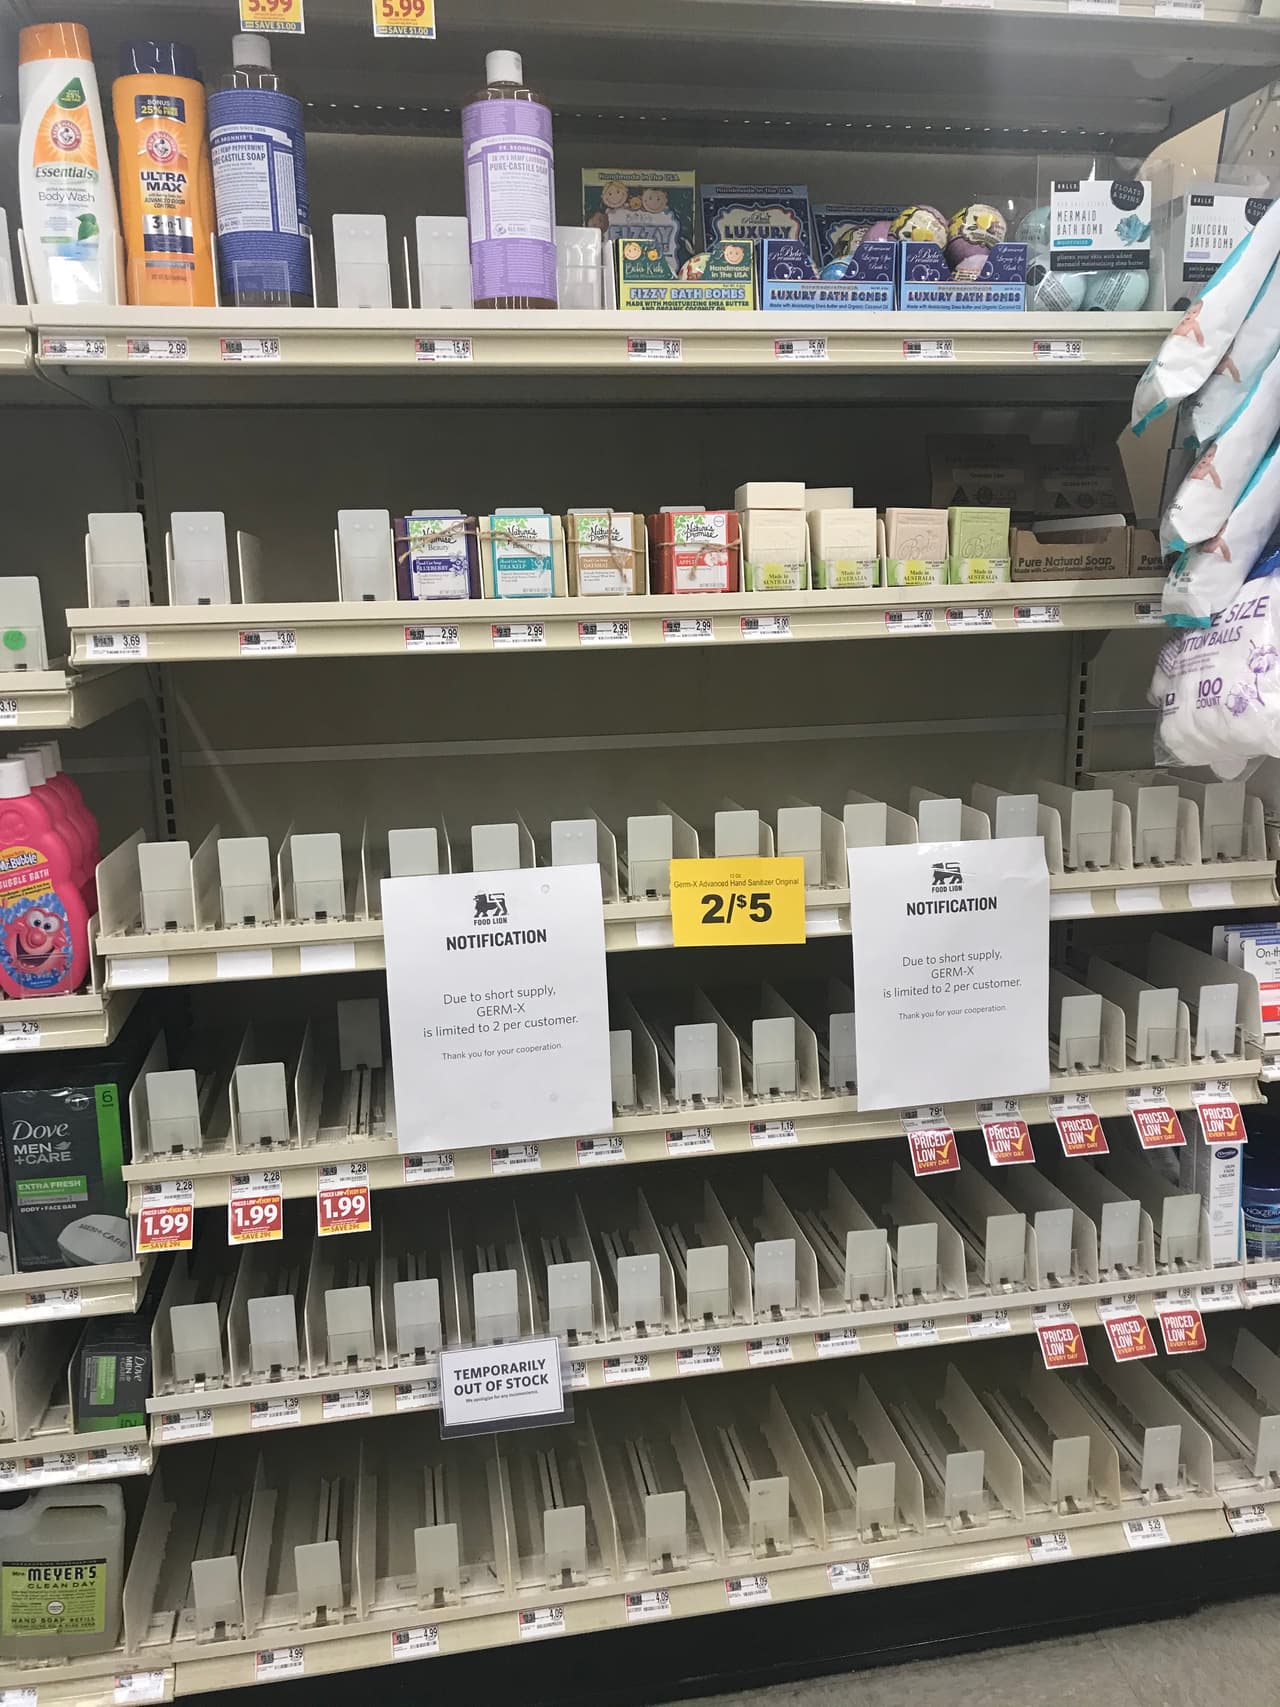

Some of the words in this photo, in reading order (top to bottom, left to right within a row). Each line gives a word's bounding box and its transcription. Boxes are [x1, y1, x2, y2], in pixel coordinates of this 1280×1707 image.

[35, 166, 96, 180] Essentials
[140, 171, 187, 184] ULTRA
[146, 182, 182, 193] MAX
[39, 191, 66, 204] Body
[67, 192, 95, 203] Wash
[1057, 210, 1096, 222] MERMAID
[1057, 224, 1077, 236] BATH
[1081, 223, 1103, 235] BOMB
[1191, 224, 1228, 236] UNICORN
[1190, 236, 1210, 248] BATH
[1212, 237, 1234, 249] BOMB
[630, 288, 667, 300] FIZZY
[671, 288, 703, 299] BATH
[705, 288, 745, 299] BOMBS
[770, 290, 816, 301] LUXURY
[819, 290, 850, 301] BATH
[851, 291, 888, 302] BOMBS
[908, 291, 952, 302] LUXURY
[955, 291, 984, 302] BATH
[985, 292, 1021, 302] BOMBS
[86, 342, 105, 353] 2.99
[168, 343, 186, 354] 2.99
[261, 341, 278, 353] 15.49
[452, 341, 470, 353] 15.49
[1065, 343, 1080, 353] 3.99
[1018, 557, 1041, 568] Pure
[1045, 556, 1083, 567] Natural
[1086, 555, 1113, 568] Soap
[1225, 595, 1270, 624] SIZE
[441, 628, 457, 639] 2.99
[527, 625, 543, 636] 2.99
[123, 635, 140, 647] 3.69
[1198, 677, 1223, 698] 100
[0, 702, 16, 712] 3.19
[1196, 696, 1221, 710] COUNT
[673, 880, 697, 889] Germ-X
[698, 879, 729, 888] Advanced
[730, 879, 747, 887] Hand
[747, 878, 774, 887] Sanitizer
[775, 878, 799, 887] Original
[931, 885, 947, 893] FOOD
[948, 884, 962, 892] LION
[700, 892, 772, 924] 2/$5
[906, 896, 997, 917] NOTIFICATION
[473, 918, 490, 926] FOOD
[492, 916, 508, 925] LION
[446, 929, 548, 951] NOTIFICATION
[902, 954, 923, 967] Due
[926, 954, 937, 965] to
[939, 950, 965, 964] short
[967, 948, 1002, 964] supply,
[930, 965, 974, 980] GERM-X
[883, 987, 891, 999] is
[894, 985, 929, 999] limited
[931, 983, 942, 995] to
[944, 982, 951, 993] 2
[953, 982, 970, 995] per
[972, 976, 1022, 991] customer.
[443, 992, 468, 1005] Due
[469, 991, 482, 1003] to
[484, 987, 514, 1002] short
[517, 984, 557, 1002] supply,
[476, 1002, 526, 1018] GERM-X
[898, 1010, 920, 1021] Thank
[921, 1010, 934, 1020] you
[935, 1008, 945, 1018] for
[947, 1008, 963, 1018] your
[964, 1003, 1007, 1016] cooperation.
[23, 1022, 40, 1033] 2.79
[423, 1026, 433, 1038] is
[435, 1022, 475, 1037] limited
[477, 1022, 490, 1034] to
[492, 1020, 501, 1032] 2
[503, 1019, 522, 1034] per
[524, 1014, 579, 1030] customer.
[442, 1050, 466, 1062] Thank
[467, 1050, 482, 1061] you
[484, 1048, 495, 1058] for
[497, 1048, 515, 1058] your
[516, 1041, 564, 1055] cooperation.
[101, 1090, 114, 1104] 6
[1138, 1110, 1169, 1125] PRICED
[1202, 1106, 1234, 1120] PRICED
[12, 1119, 70, 1141] Dove
[1061, 1118, 1093, 1133] PRICED
[1142, 1123, 1162, 1137] LOW
[1206, 1118, 1225, 1132] LOW
[697, 1128, 711, 1138] 1.19
[988, 1124, 1020, 1141] PRICED
[1064, 1131, 1084, 1145] LOW
[608, 1138, 623, 1148] 1.19
[914, 1134, 947, 1149] PRICED
[990, 1139, 1012, 1153] LOW
[14, 1142, 52, 1155] MEN
[524, 1146, 539, 1156] 1.19
[15, 1152, 72, 1165] +CARE
[438, 1155, 453, 1165] 1.19
[916, 1149, 937, 1163] LOW
[350, 1163, 367, 1173] 2.28
[263, 1171, 280, 1182] 2.28
[18, 1181, 49, 1191] EXTRA
[51, 1180, 81, 1189] FRESH
[176, 1181, 193, 1192] 2.28
[322, 1196, 366, 1218] 1.99
[234, 1204, 278, 1226] 1.99
[144, 1214, 188, 1236] 1.99
[62, 1288, 80, 1300] 7.49
[995, 1310, 1008, 1319] 2.19
[922, 1319, 935, 1329] 2.19
[1109, 1320, 1140, 1335] PRICED
[844, 1329, 856, 1338] 2.19
[1113, 1334, 1132, 1348] LOW
[453, 1357, 546, 1380] TEMPORARILY
[570, 1361, 585, 1372] 1.39
[453, 1380, 483, 1396] OUT
[486, 1378, 504, 1393] OF
[506, 1371, 549, 1391] STOCK
[354, 1389, 370, 1399] 1.39
[284, 1398, 299, 1408] 1.39
[60, 1453, 75, 1464] 2.39
[856, 1560, 869, 1572] 4.09
[28, 1566, 97, 1581] MEYER'S
[72, 1580, 95, 1588] DAY
[754, 1575, 768, 1586] 4.09
[655, 1591, 669, 1602] 4.09
[423, 1628, 437, 1639] 4.99
